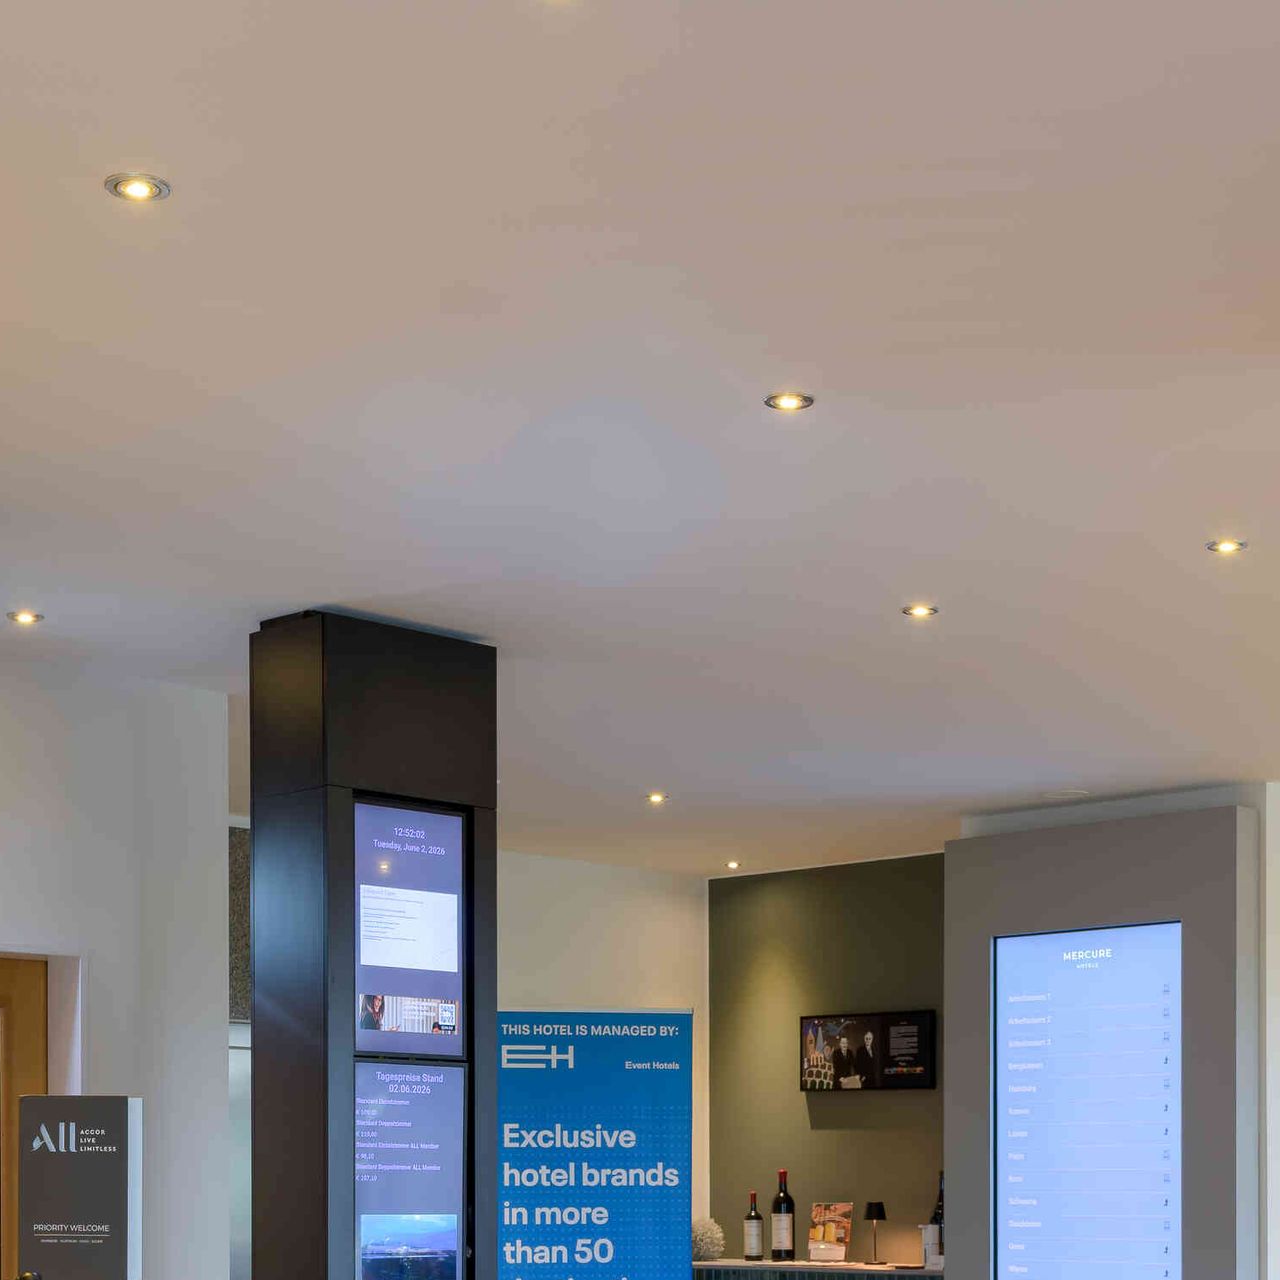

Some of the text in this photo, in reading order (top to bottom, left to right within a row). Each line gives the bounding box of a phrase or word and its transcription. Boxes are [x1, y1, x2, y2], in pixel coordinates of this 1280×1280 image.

[372, 840, 402, 853] Tuesday,
[403, 843, 421, 853] June
[428, 846, 446, 855] 2026
[1063, 949, 1113, 961] MERCURE
[501, 1024, 679, 1037] THIS HOTEL IS MANAGED BY:
[625, 1061, 680, 1070] Event Hotels
[422, 1073, 444, 1083] Stand
[388, 1084, 431, 1094] 02.06.2026
[30, 1122, 78, 1153] All
[503, 1123, 636, 1148] Exclusive
[503, 1162, 680, 1187] hotel brands
[503, 1201, 610, 1226] in more
[33, 1223, 110, 1232] PRIORITY WELCOME
[503, 1238, 615, 1264] than 50
